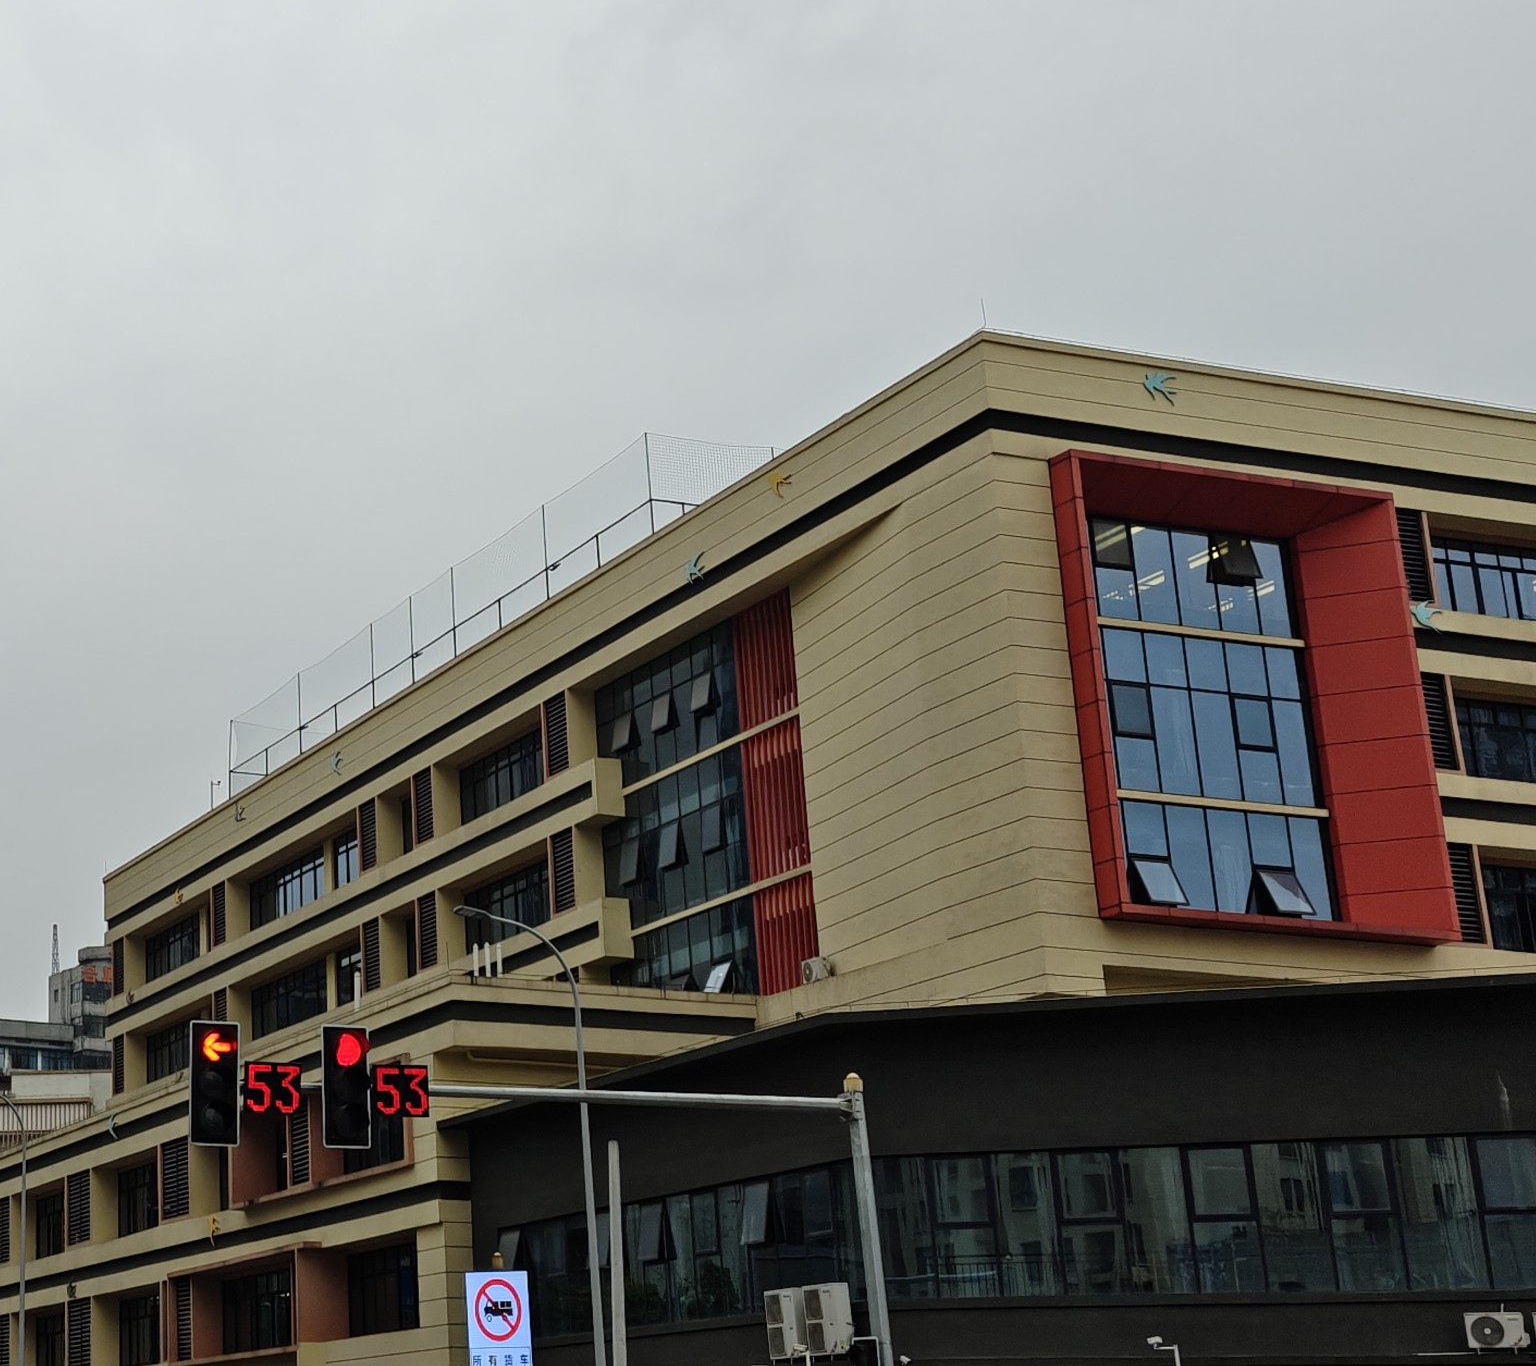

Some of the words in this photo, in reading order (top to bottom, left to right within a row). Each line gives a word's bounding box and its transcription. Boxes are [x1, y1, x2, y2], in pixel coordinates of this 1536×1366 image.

[247, 1064, 300, 1114] 53
[376, 1068, 427, 1115] 53
[472, 1354, 529, 1366] 所有货车
